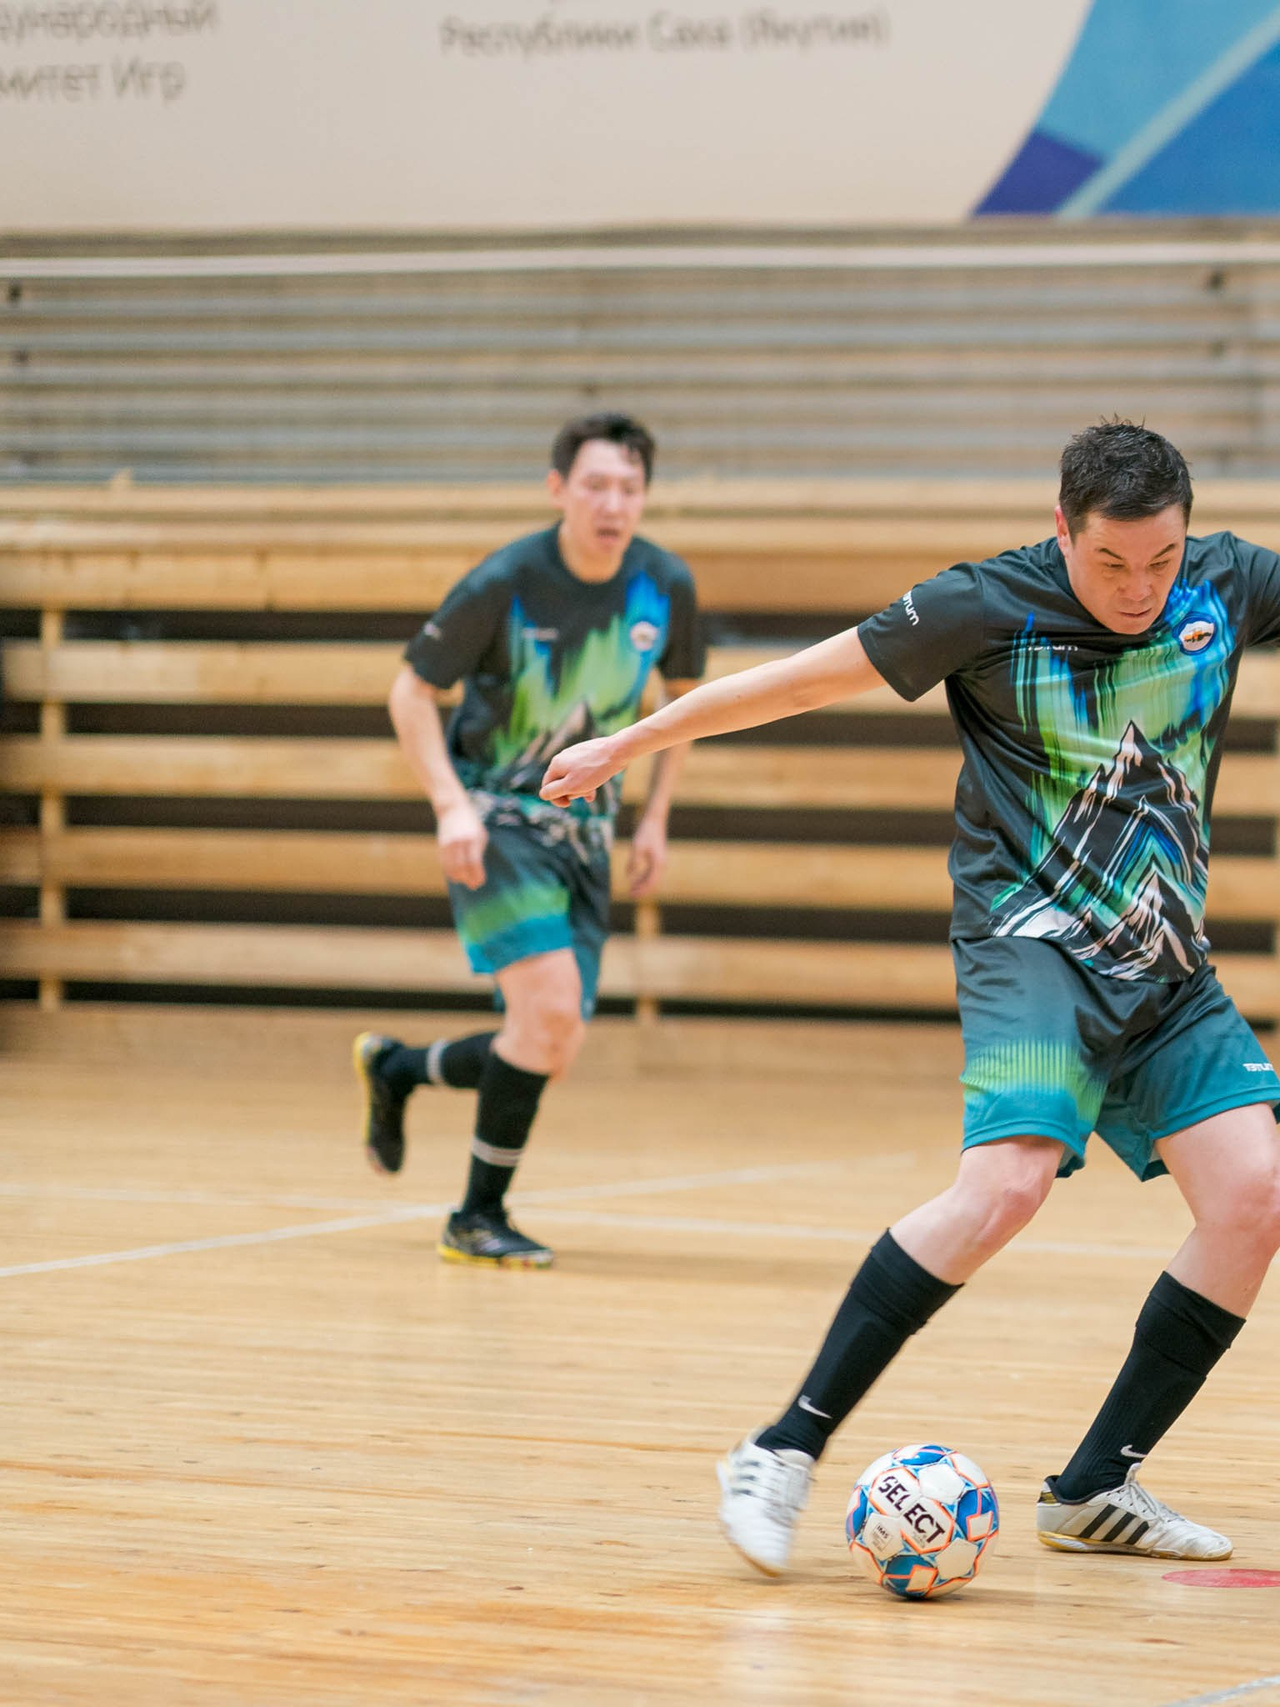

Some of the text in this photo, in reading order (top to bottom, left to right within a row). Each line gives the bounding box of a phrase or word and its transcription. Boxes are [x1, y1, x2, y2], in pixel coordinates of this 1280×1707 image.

[440, 13, 637, 57] Республики
[649, 10, 731, 51] Саха
[878, 1476, 945, 1543] SELECT
